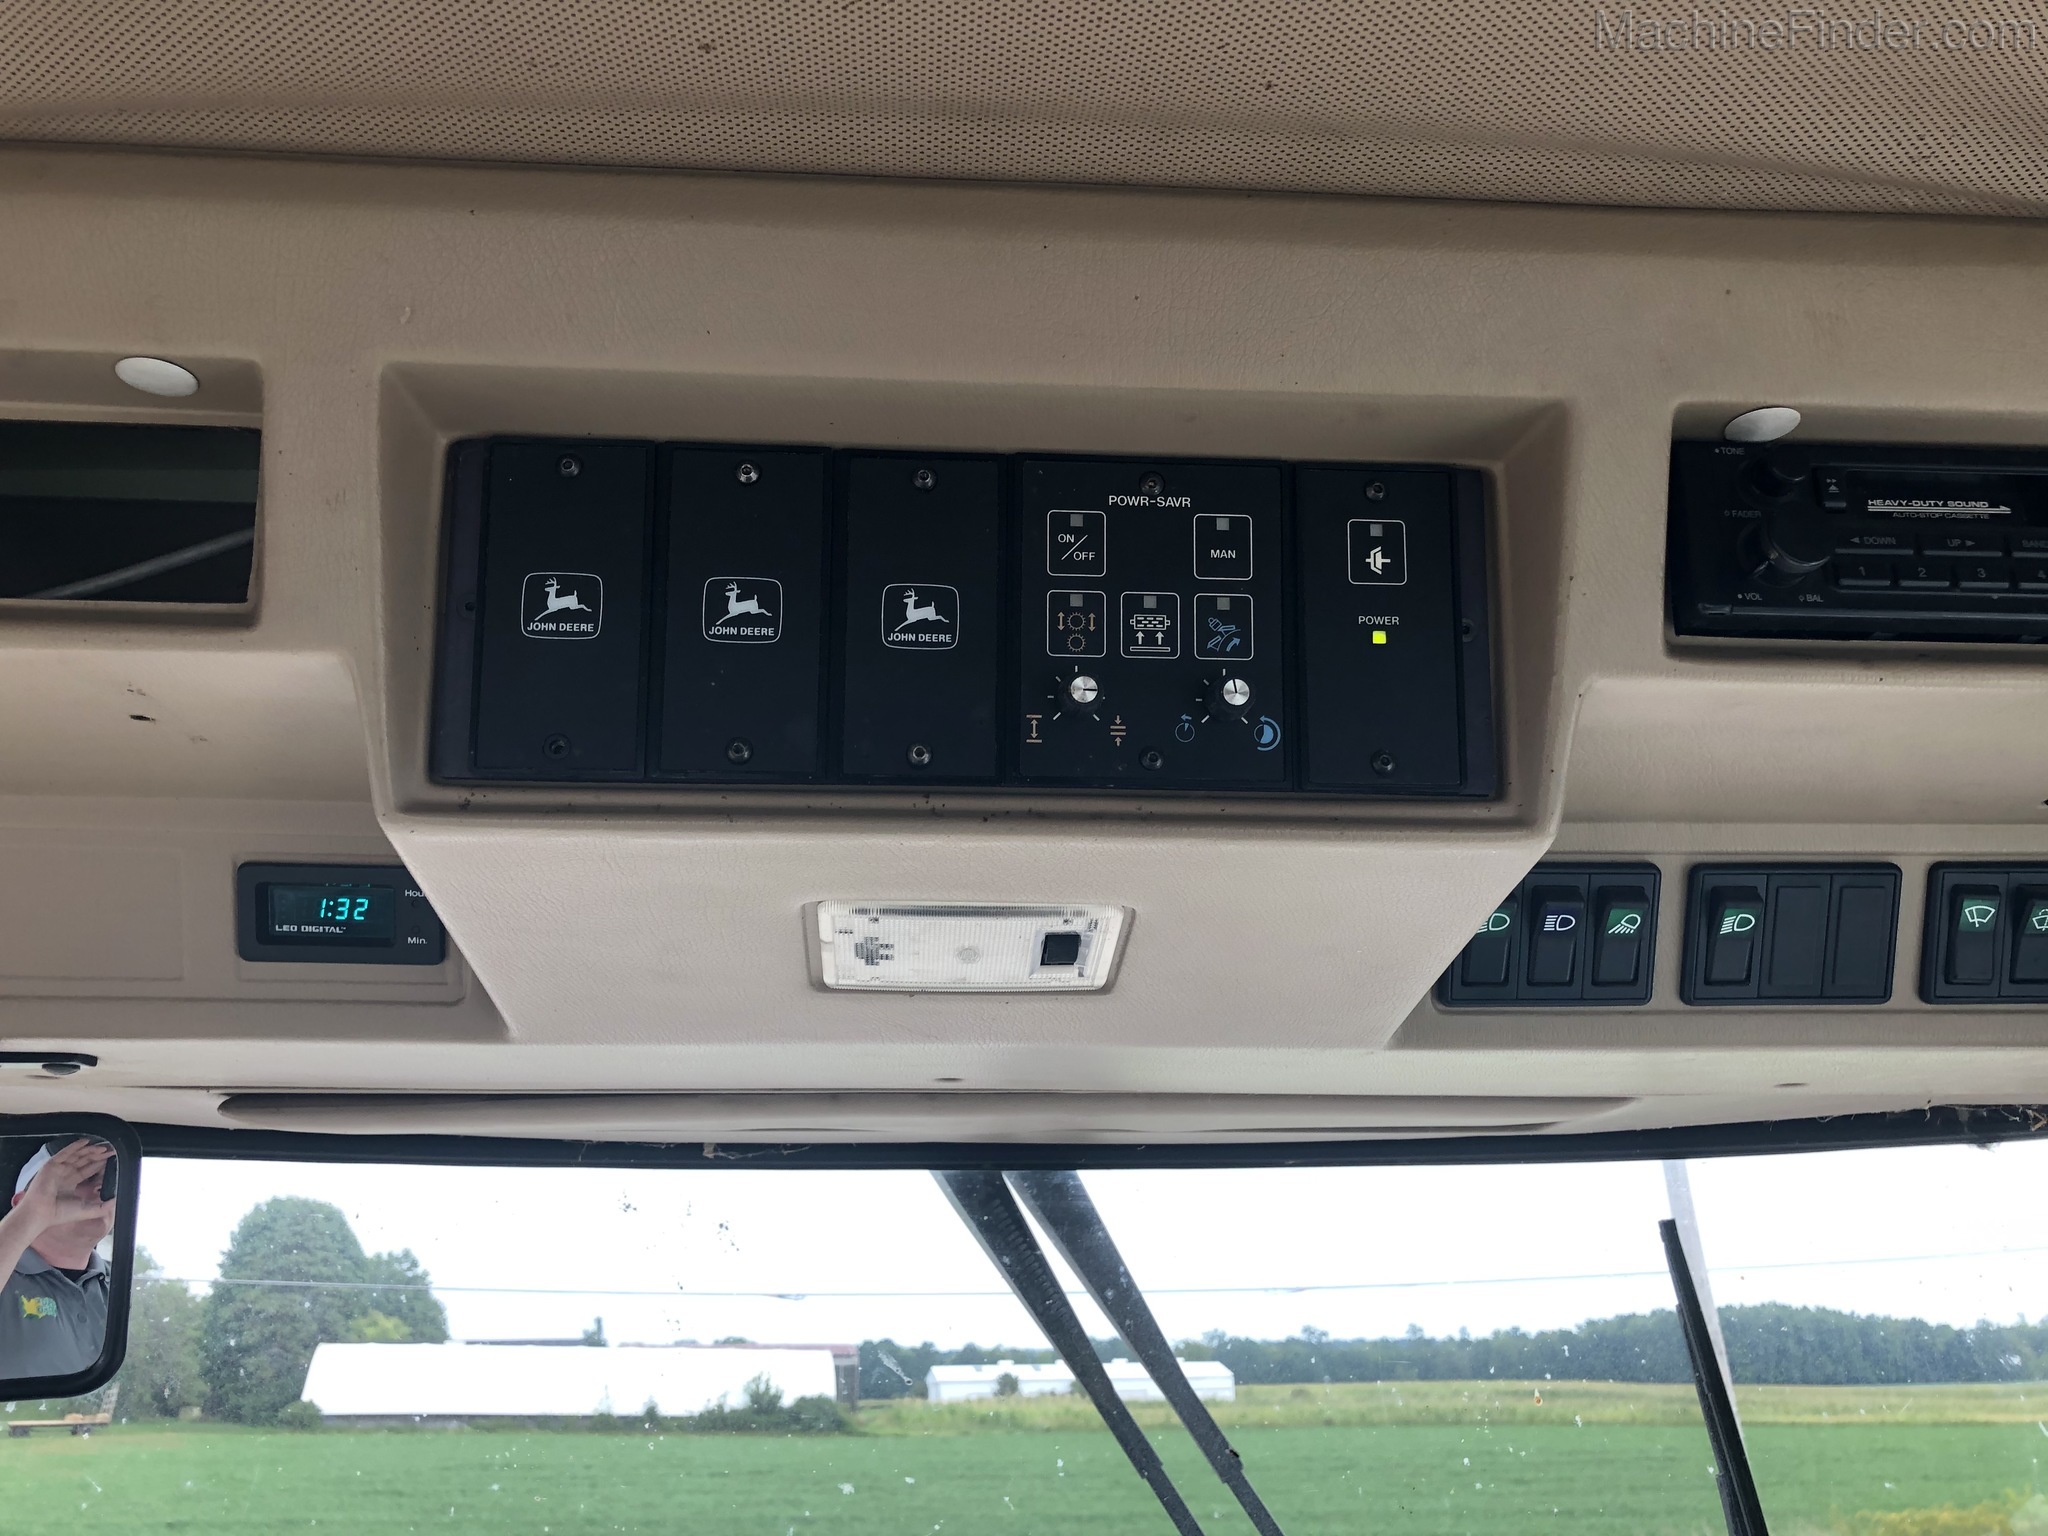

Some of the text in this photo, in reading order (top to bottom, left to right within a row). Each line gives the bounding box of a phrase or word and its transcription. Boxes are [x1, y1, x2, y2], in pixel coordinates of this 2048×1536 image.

[1720, 447, 1745, 456] TONE
[1108, 495, 1191, 508] POWR-SAVR
[1867, 499, 1989, 508] HEAVY-DUTY SOUND
[1732, 510, 1762, 519] FADER
[1892, 511, 1990, 520] AUTO-STOP CASSETTE
[1057, 533, 1075, 543] ON
[1864, 536, 1896, 546] DOWN
[1946, 538, 1962, 548] UP
[1073, 551, 1096, 561] OFF
[1210, 550, 1236, 559] MAN
[1858, 566, 1866, 576] 1
[1917, 567, 1928, 578] 2
[1977, 568, 1987, 578] 3
[1743, 593, 1763, 601] VOL
[1806, 594, 1824, 603] BAL
[1357, 615, 1400, 626] POWER
[527, 622, 595, 632] JOHN DEERE
[708, 626, 775, 636] JOHN DEERE
[887, 632, 952, 643] JOHN DEERE
[404, 888, 426, 897] Hou
[319, 897, 369, 921] 1:32
[407, 936, 428, 945] Min.
